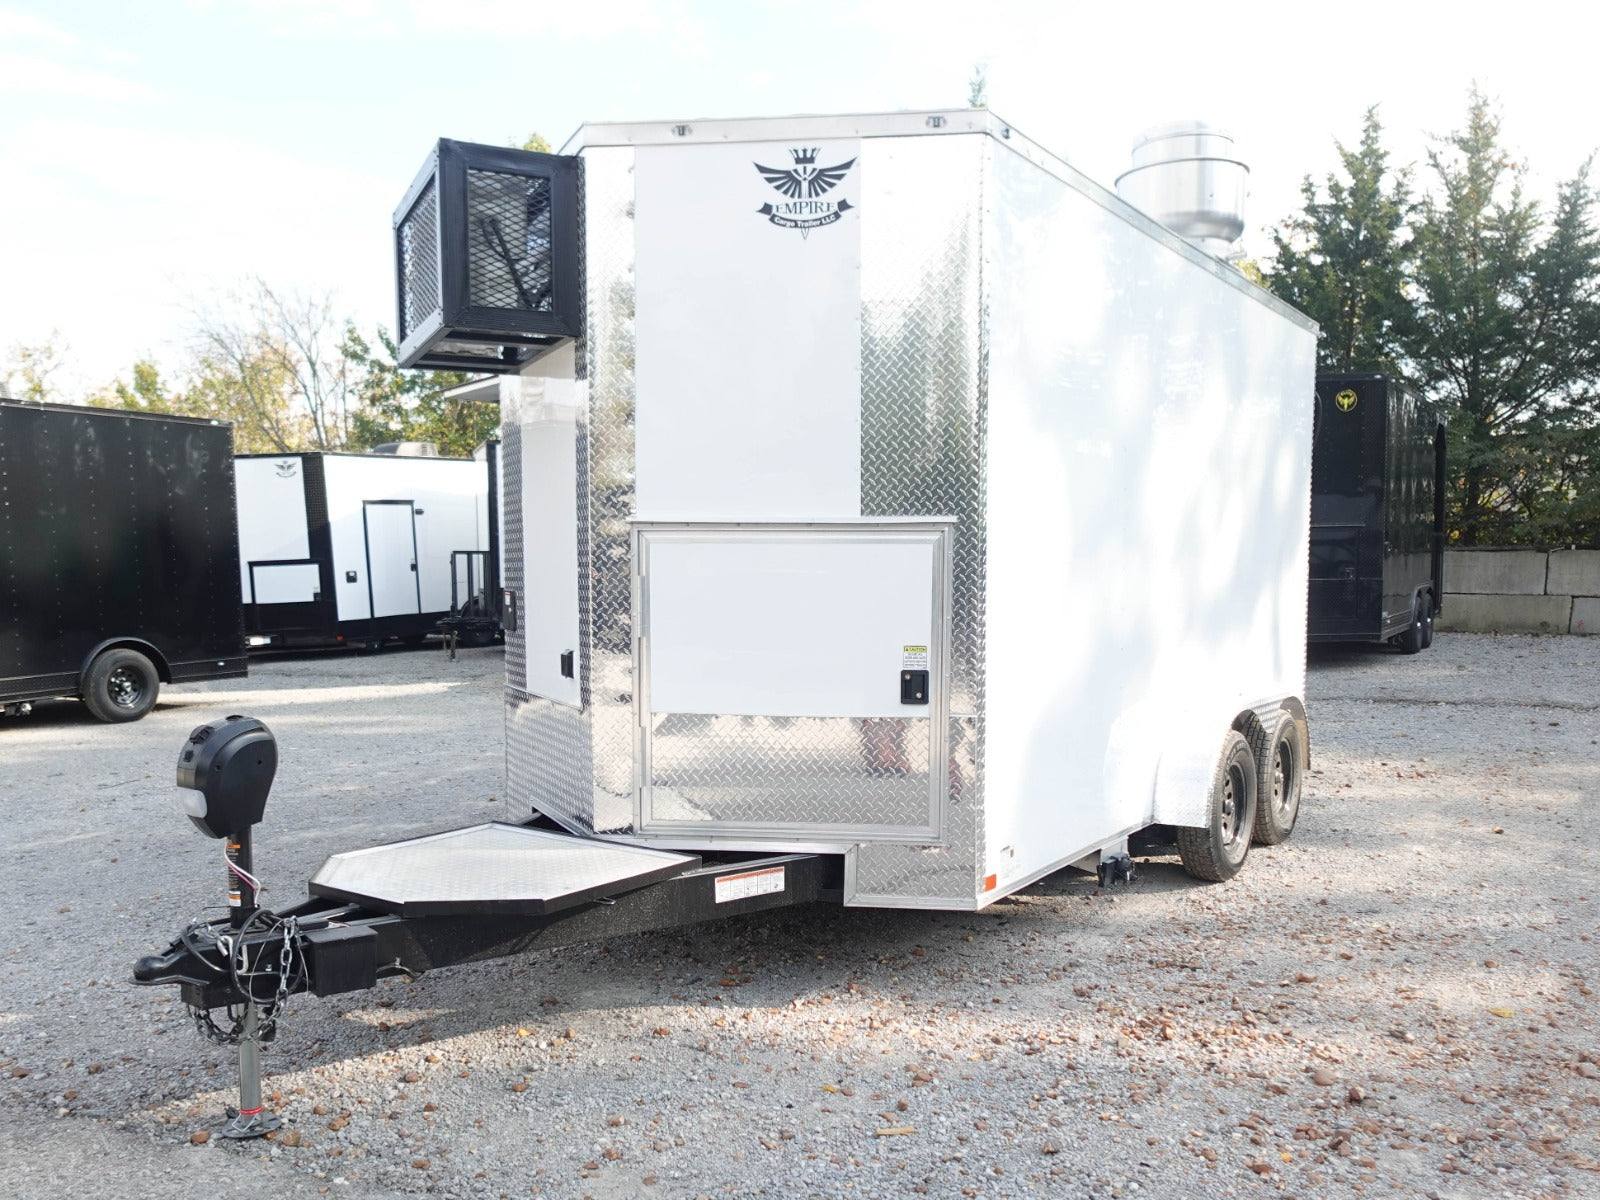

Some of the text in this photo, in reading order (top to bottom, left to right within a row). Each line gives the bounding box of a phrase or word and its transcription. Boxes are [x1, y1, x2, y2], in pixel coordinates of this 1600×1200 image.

[775, 201, 835, 214] EMPIRE
[774, 214, 836, 228] Cargo Trailer LLC
